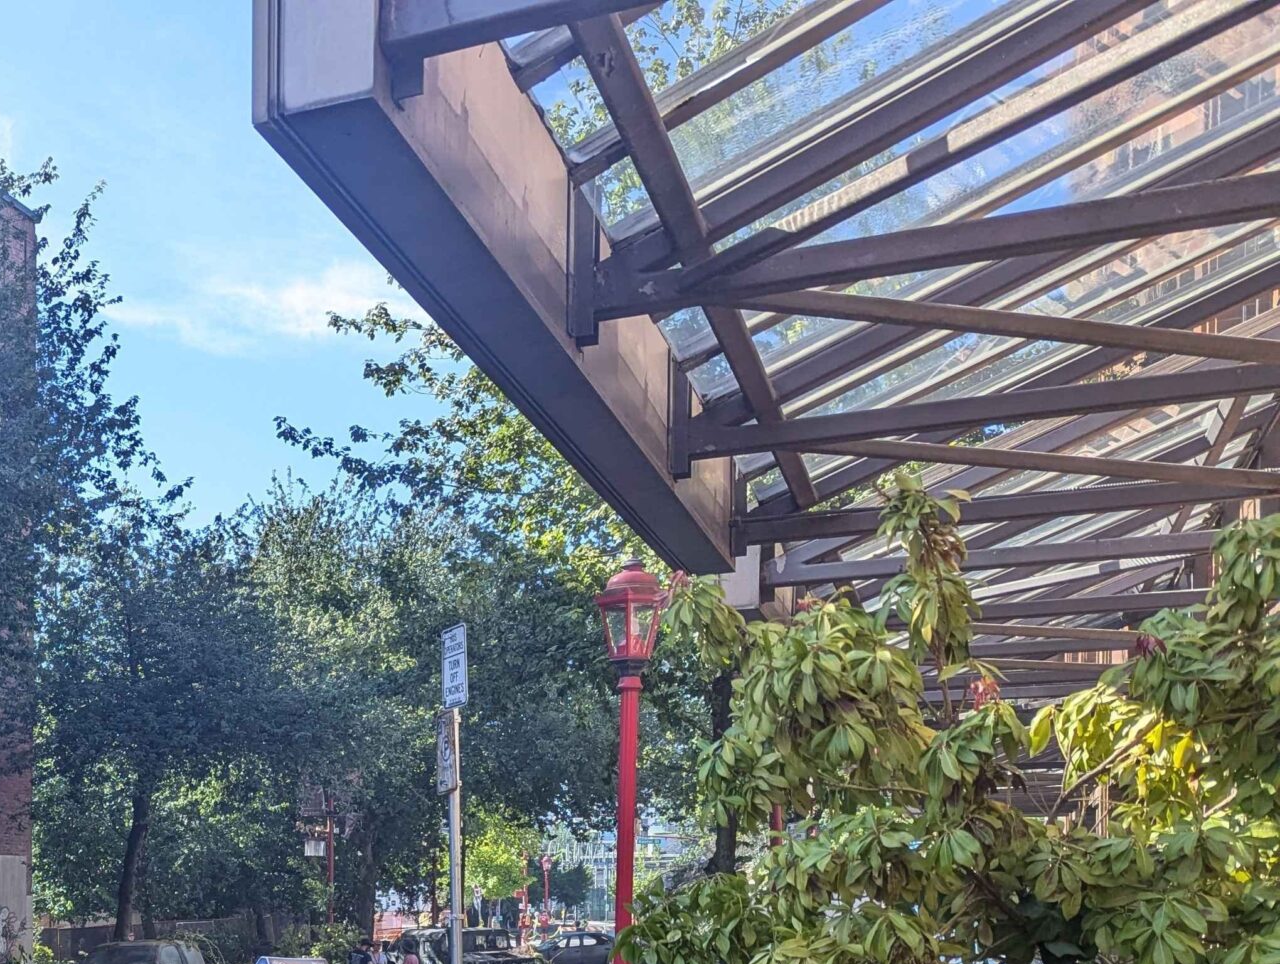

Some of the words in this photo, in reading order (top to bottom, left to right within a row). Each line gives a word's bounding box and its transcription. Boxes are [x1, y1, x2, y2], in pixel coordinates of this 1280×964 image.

[448, 659, 460, 671] TURN
[450, 671, 459, 683] OFF
[446, 682, 464, 697] ENGINES
